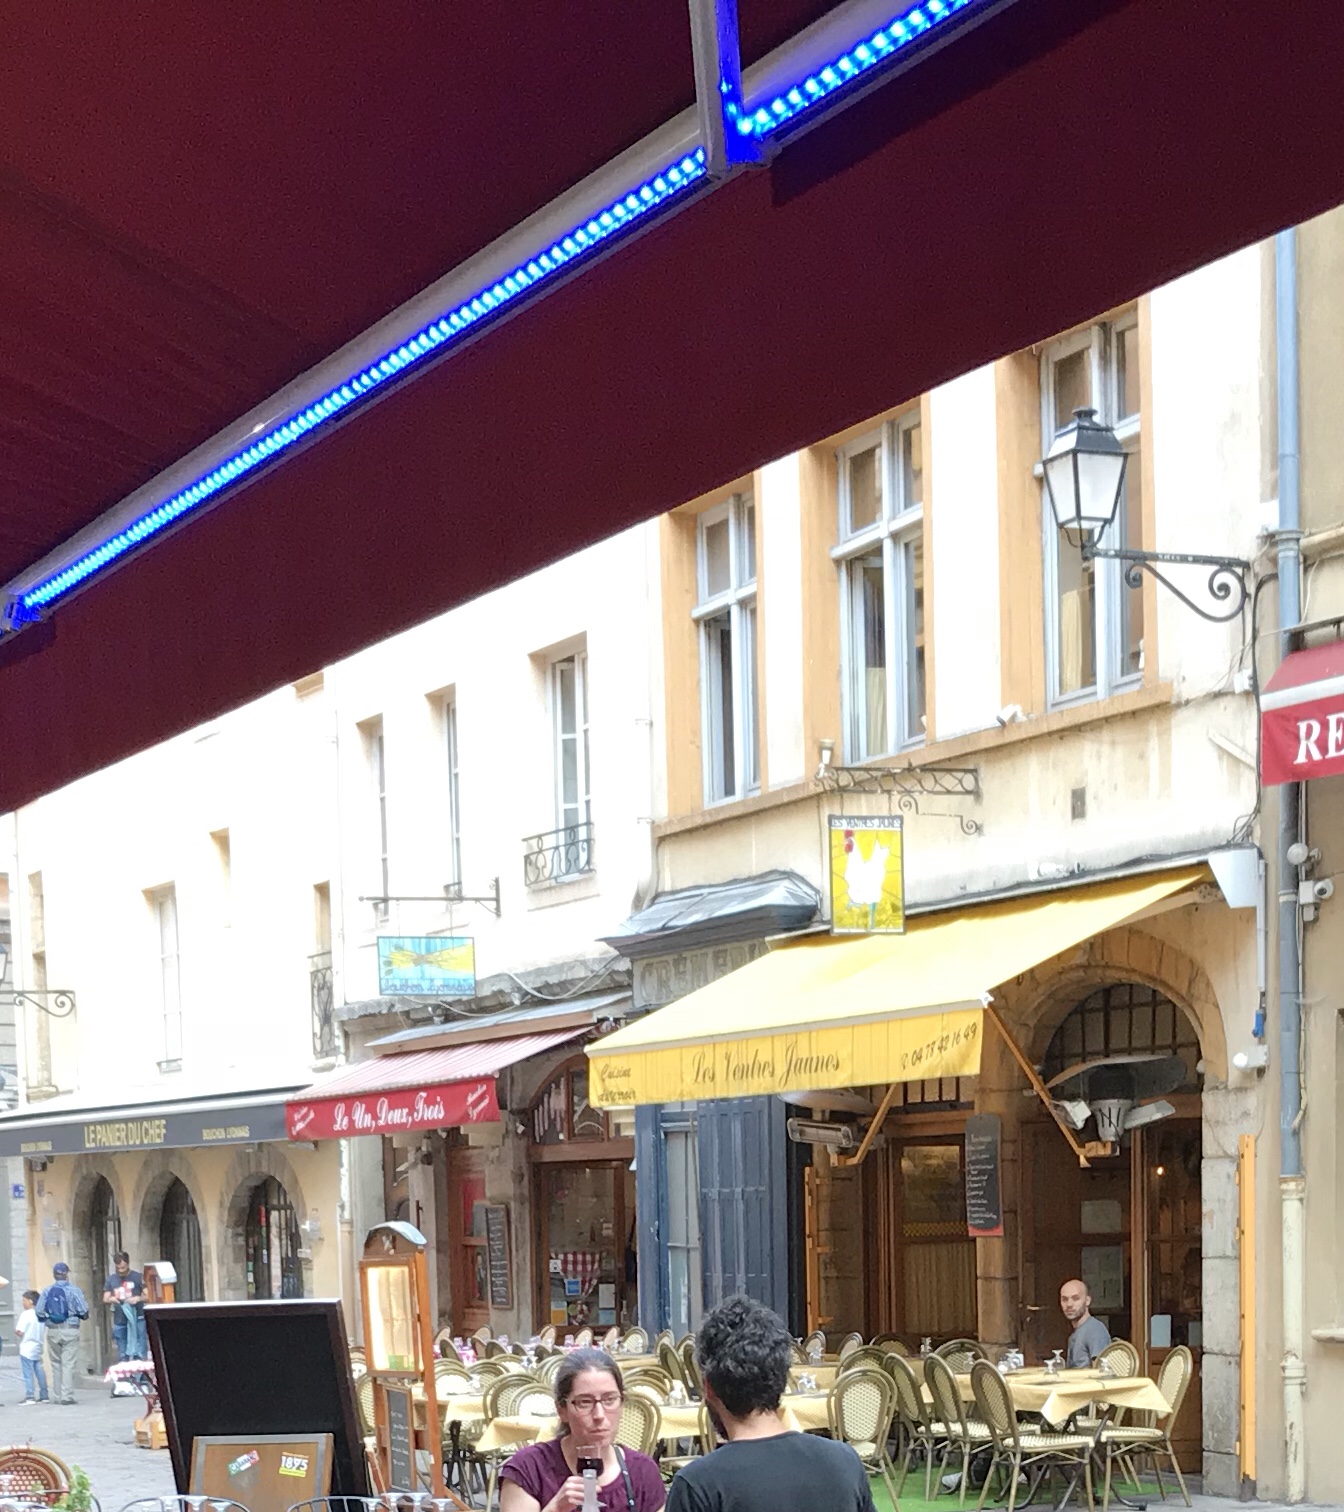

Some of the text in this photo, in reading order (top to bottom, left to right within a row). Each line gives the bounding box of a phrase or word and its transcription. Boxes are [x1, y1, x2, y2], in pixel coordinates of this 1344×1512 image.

[691, 1040, 840, 1088] Les Ventres Jaunes
[332, 1102, 348, 1131] Le
[377, 1096, 412, 1128] Deux,
[414, 1091, 445, 1122] Trois
[84, 1119, 167, 1148] LE PANIER DU CHEF
[281, 1455, 308, 1472] 1895
